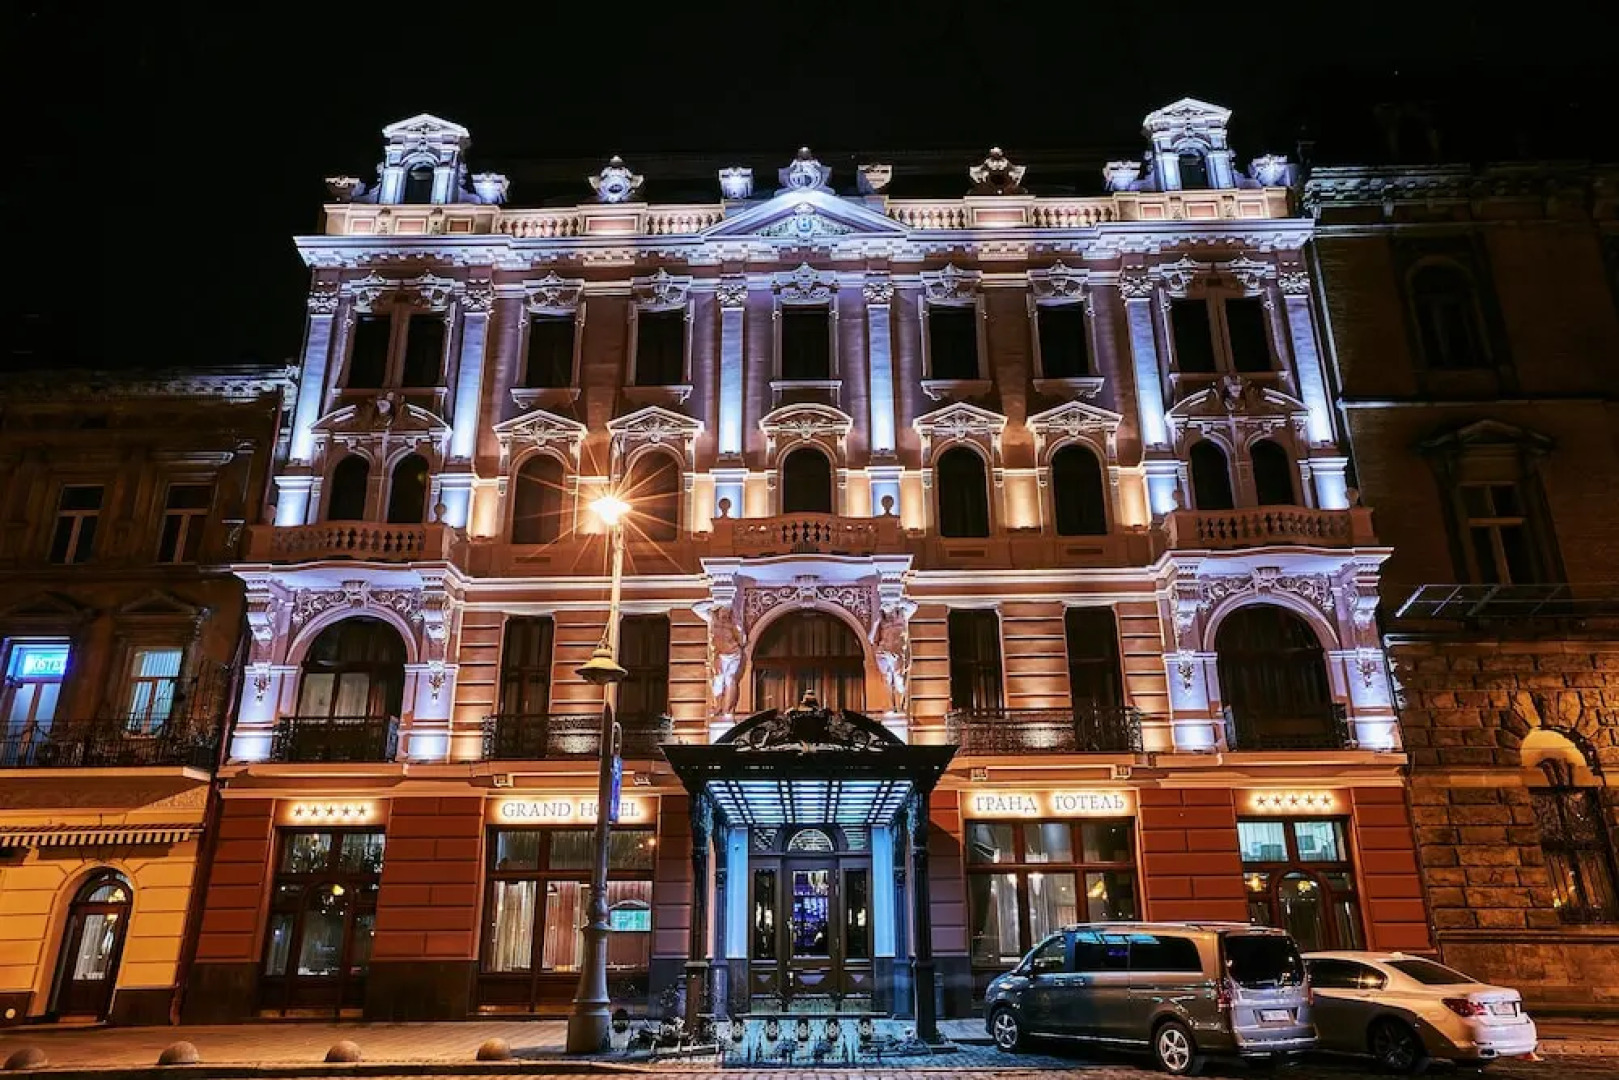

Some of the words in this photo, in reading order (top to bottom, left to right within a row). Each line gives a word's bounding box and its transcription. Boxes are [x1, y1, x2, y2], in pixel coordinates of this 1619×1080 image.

[502, 802, 571, 817] GRAND
[580, 802, 640, 817] HEL
[976, 797, 1037, 813] ГРАНД
[1055, 795, 1124, 811] ГОТЕЛЬ
